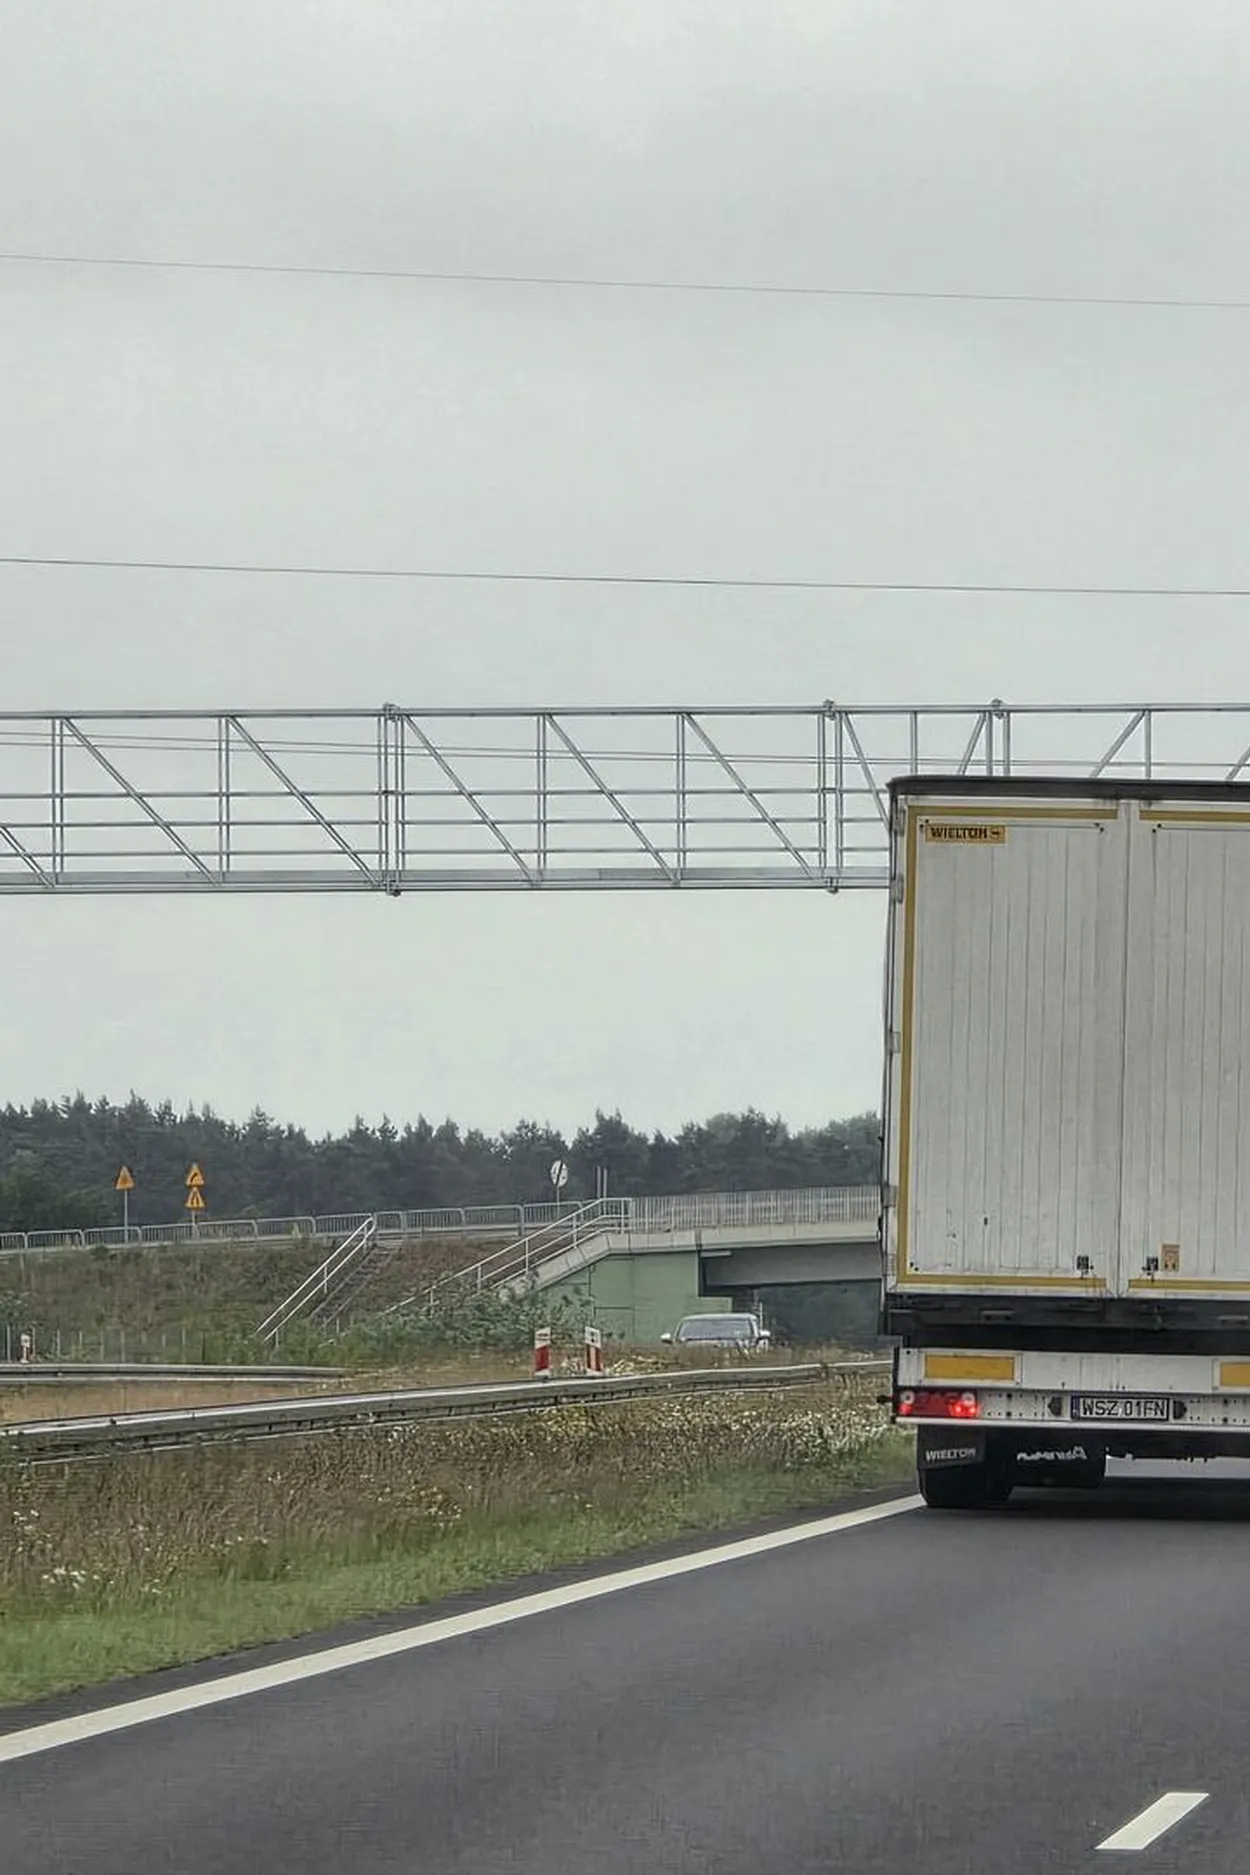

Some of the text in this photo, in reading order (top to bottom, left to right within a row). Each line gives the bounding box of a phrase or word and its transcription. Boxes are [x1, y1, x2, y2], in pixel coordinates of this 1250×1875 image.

[930, 826, 988, 839] WIELTON
[1082, 1399, 1165, 1417] WSZ 01FN
